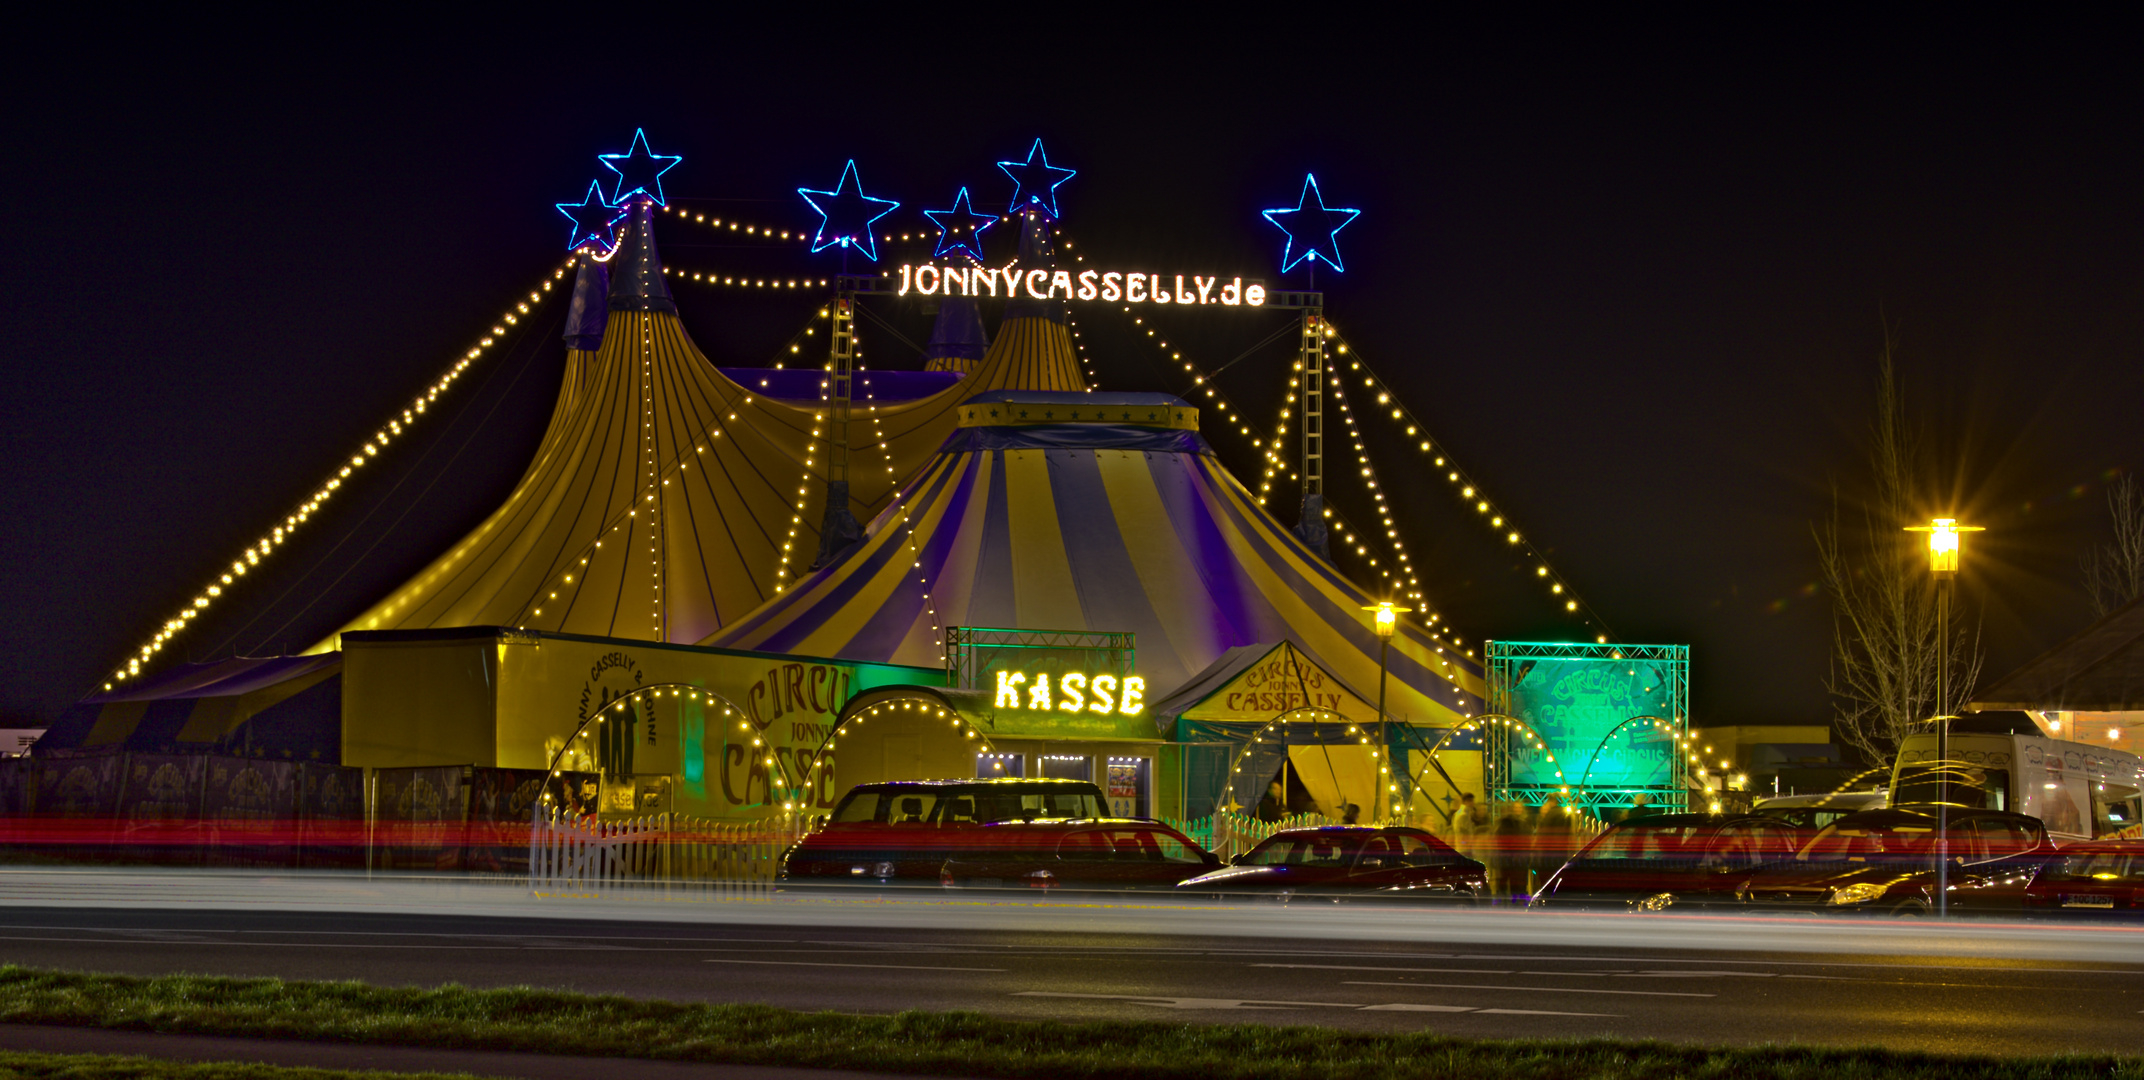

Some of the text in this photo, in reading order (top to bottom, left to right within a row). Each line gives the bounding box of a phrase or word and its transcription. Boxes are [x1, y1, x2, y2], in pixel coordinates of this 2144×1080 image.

[898, 264, 1267, 306] JONNYCASSELLY.de
[577, 681, 592, 738] ONNY
[591, 652, 636, 682] CASSELLY
[994, 670, 1146, 716] KASSE
[1246, 660, 1325, 689] CIRCUS
[1551, 669, 1630, 701] CIRCUS
